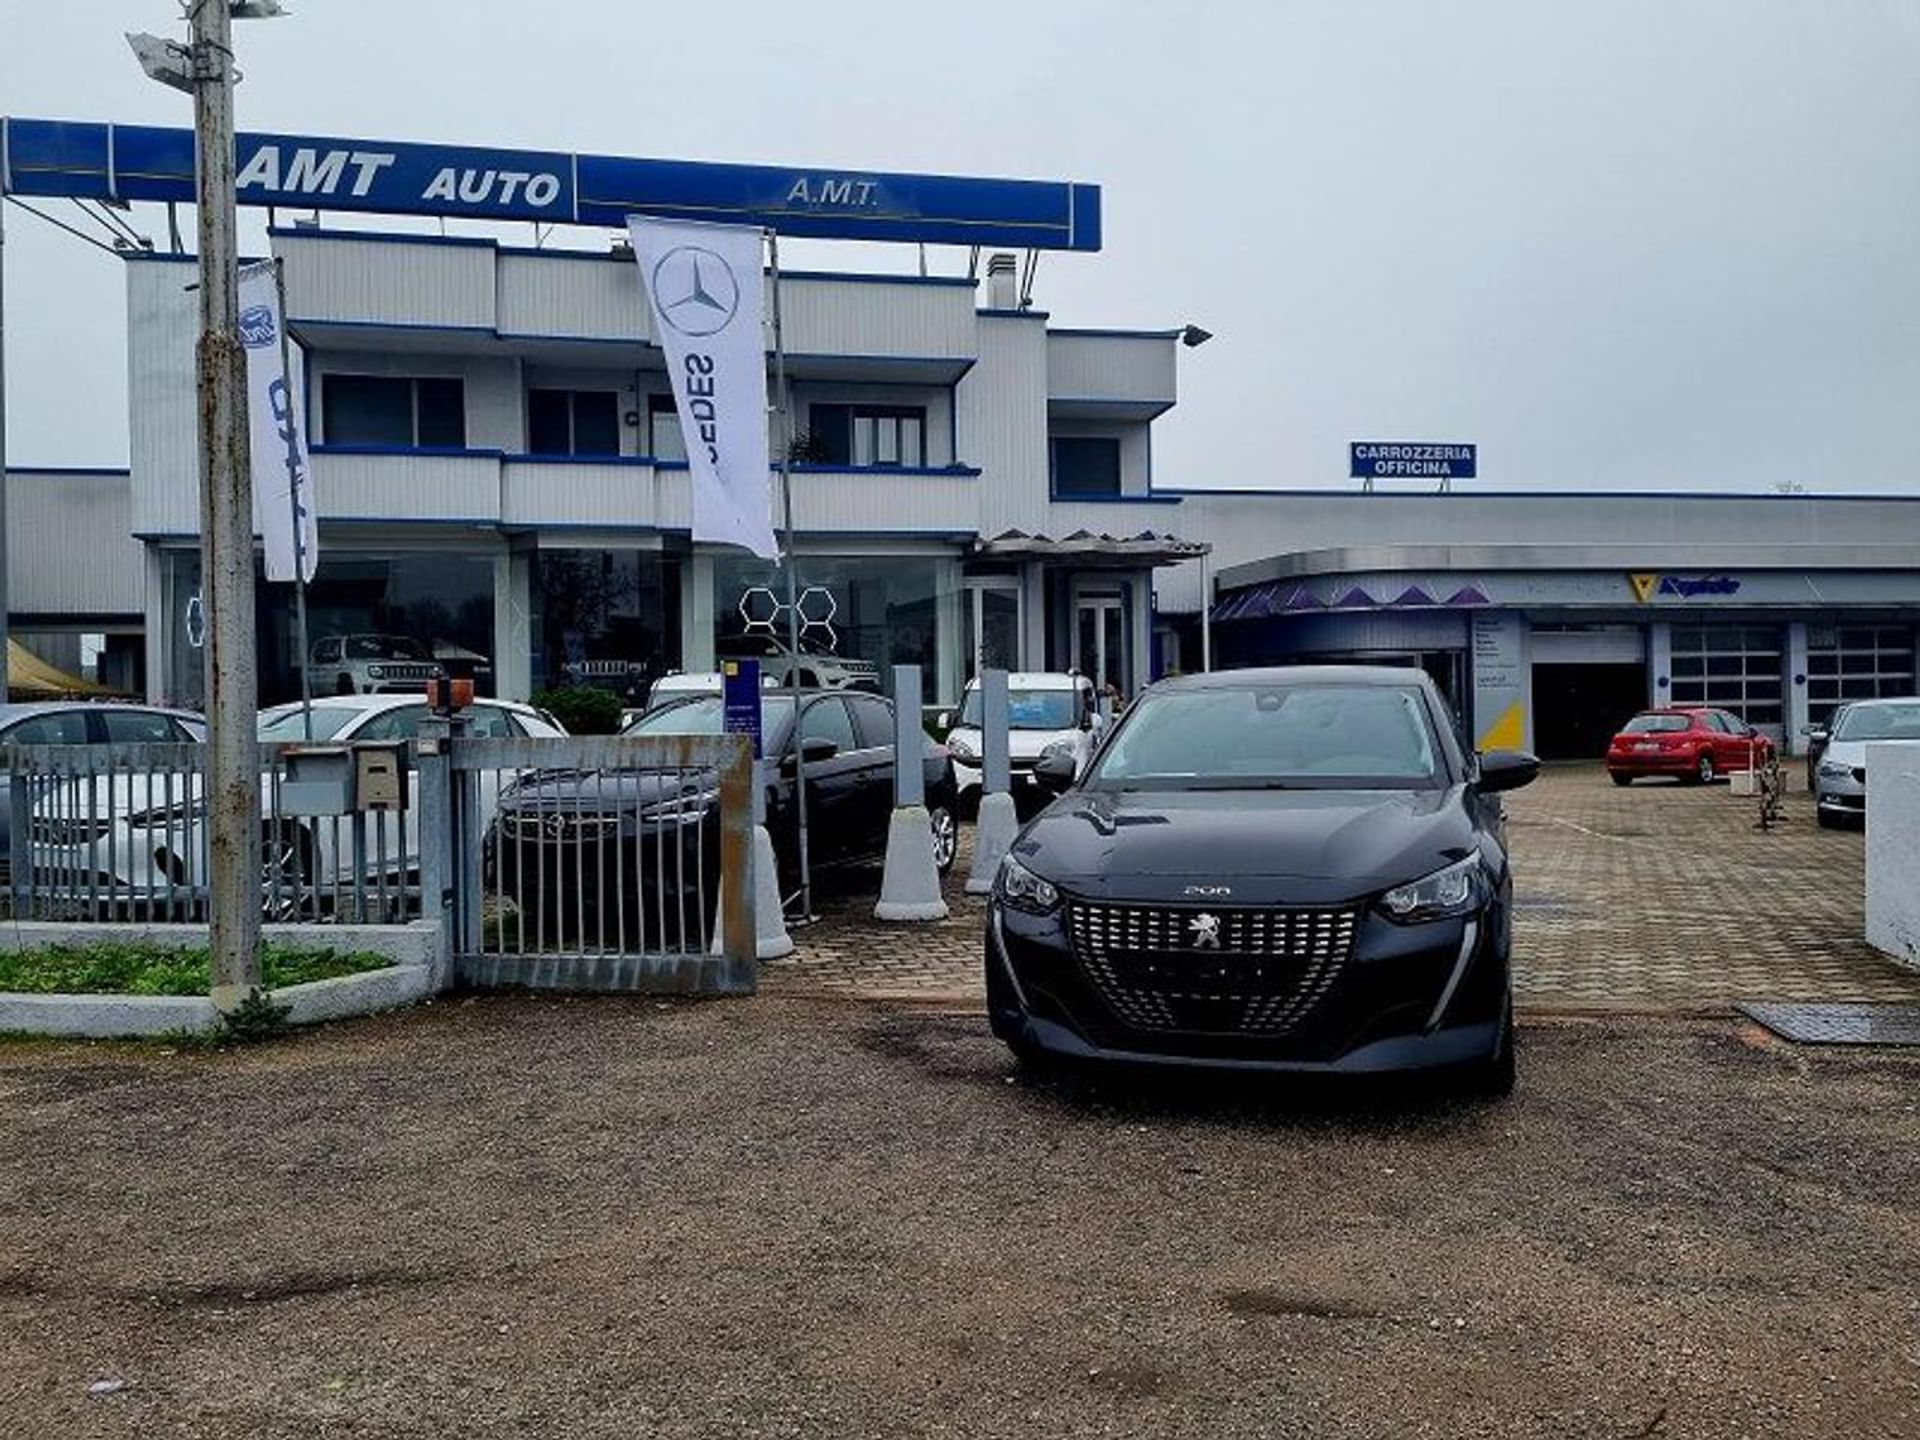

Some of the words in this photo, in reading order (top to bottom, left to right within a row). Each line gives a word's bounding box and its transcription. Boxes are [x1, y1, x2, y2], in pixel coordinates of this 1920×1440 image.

[235, 146, 396, 196] AMT
[421, 167, 561, 206] AUTO
[786, 178, 878, 206] A.M.T.
[1355, 445, 1471, 459] CARROZZERIA
[1374, 461, 1451, 474] OFFICINA
